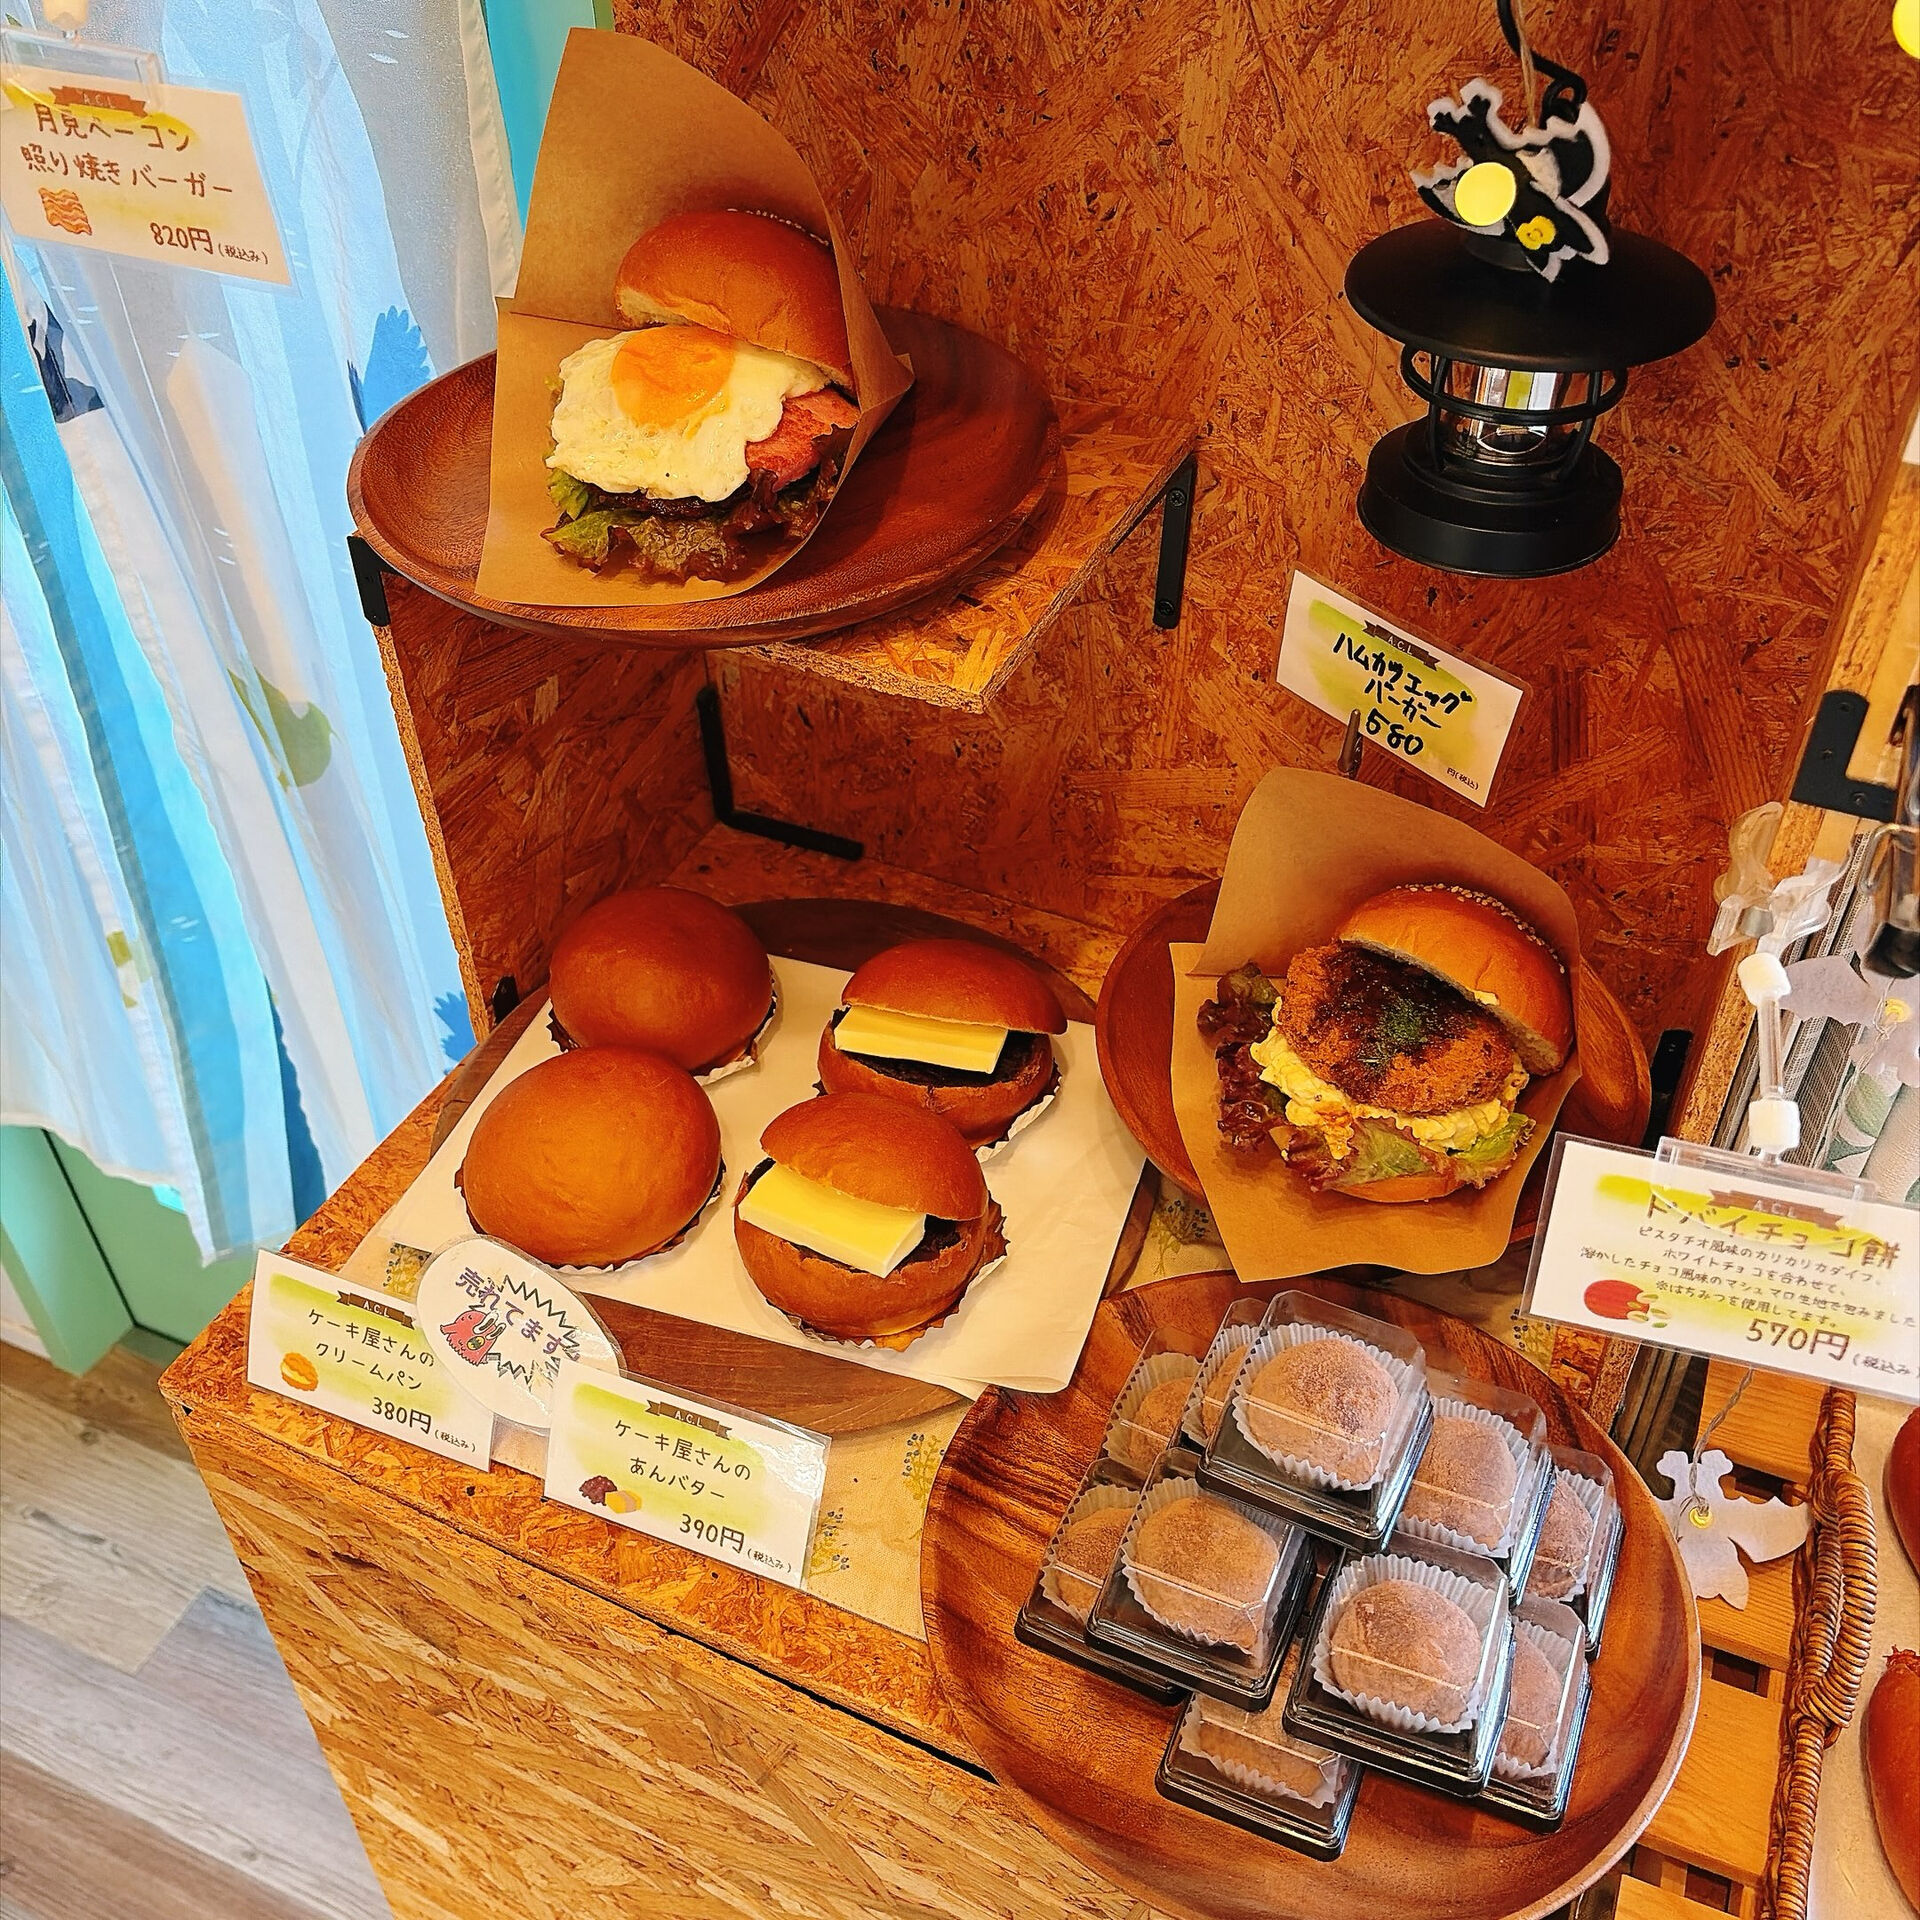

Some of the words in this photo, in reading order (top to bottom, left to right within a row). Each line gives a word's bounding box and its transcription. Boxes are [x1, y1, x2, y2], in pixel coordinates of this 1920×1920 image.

[34, 103, 190, 151] 月見ベーコン
[20, 143, 233, 197] 照り焼きバーガー
[150, 222, 213, 254] 820円
[218, 243, 268, 265] (税込み)
[1387, 635, 1412, 655] A.C.L
[1333, 633, 1473, 714] ハムカツエッグ
[1364, 679, 1441, 729] バーガー
[1366, 708, 1424, 756] 580
[1647, 1194, 1901, 1269] ドバイチョコ餅
[362, 1300, 391, 1318] A.C.L
[308, 1308, 434, 1367] ケーキ屋さんの
[1746, 1318, 1850, 1361] 570円
[316, 1342, 423, 1390] クリームパン
[372, 1396, 432, 1434] 380円
[434, 1429, 476, 1452] (税込み)
[675, 1410, 704, 1428] A.C.L
[614, 1420, 751, 1481] ケーキ屋さんの
[629, 1457, 725, 1499] あんバター
[679, 1513, 745, 1553] 390円
[746, 1548, 792, 1573] (税込み)
